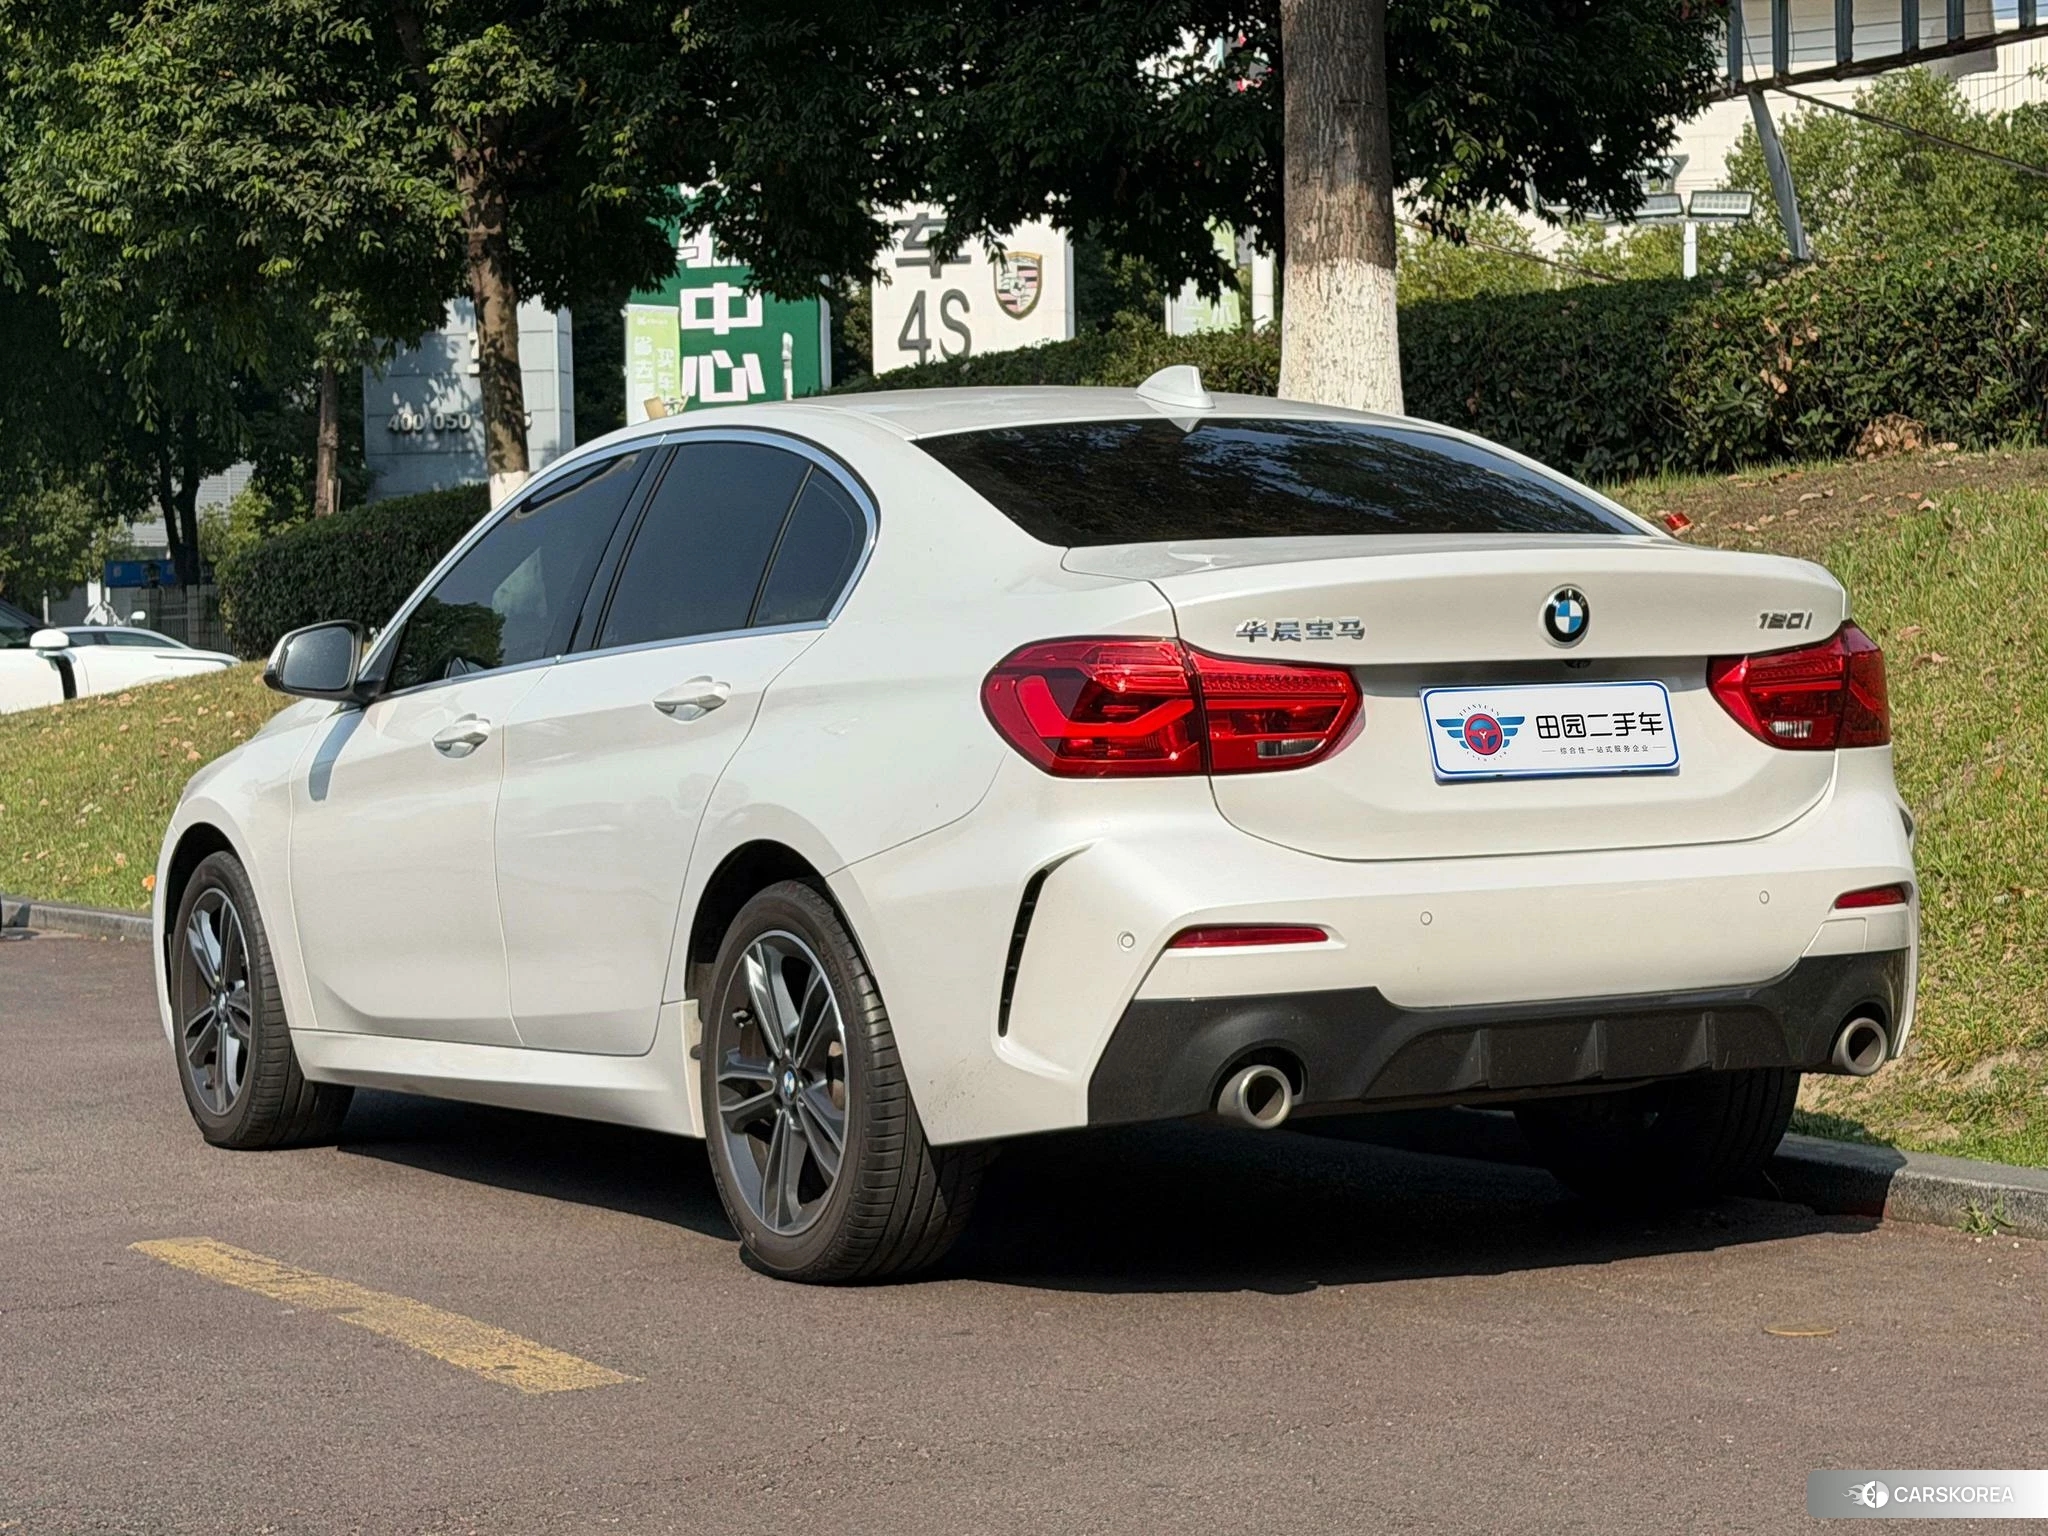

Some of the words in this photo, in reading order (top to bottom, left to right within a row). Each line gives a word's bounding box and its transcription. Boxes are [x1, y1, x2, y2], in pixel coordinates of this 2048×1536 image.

[898, 289, 972, 364] 4S
[388, 412, 425, 431] 400
[433, 412, 472, 431] 050
[1235, 616, 1366, 643] 华晨宝马
[1536, 712, 1663, 739] 田园二手车
[1560, 744, 1649, 755] 综合性一站式服务企业
